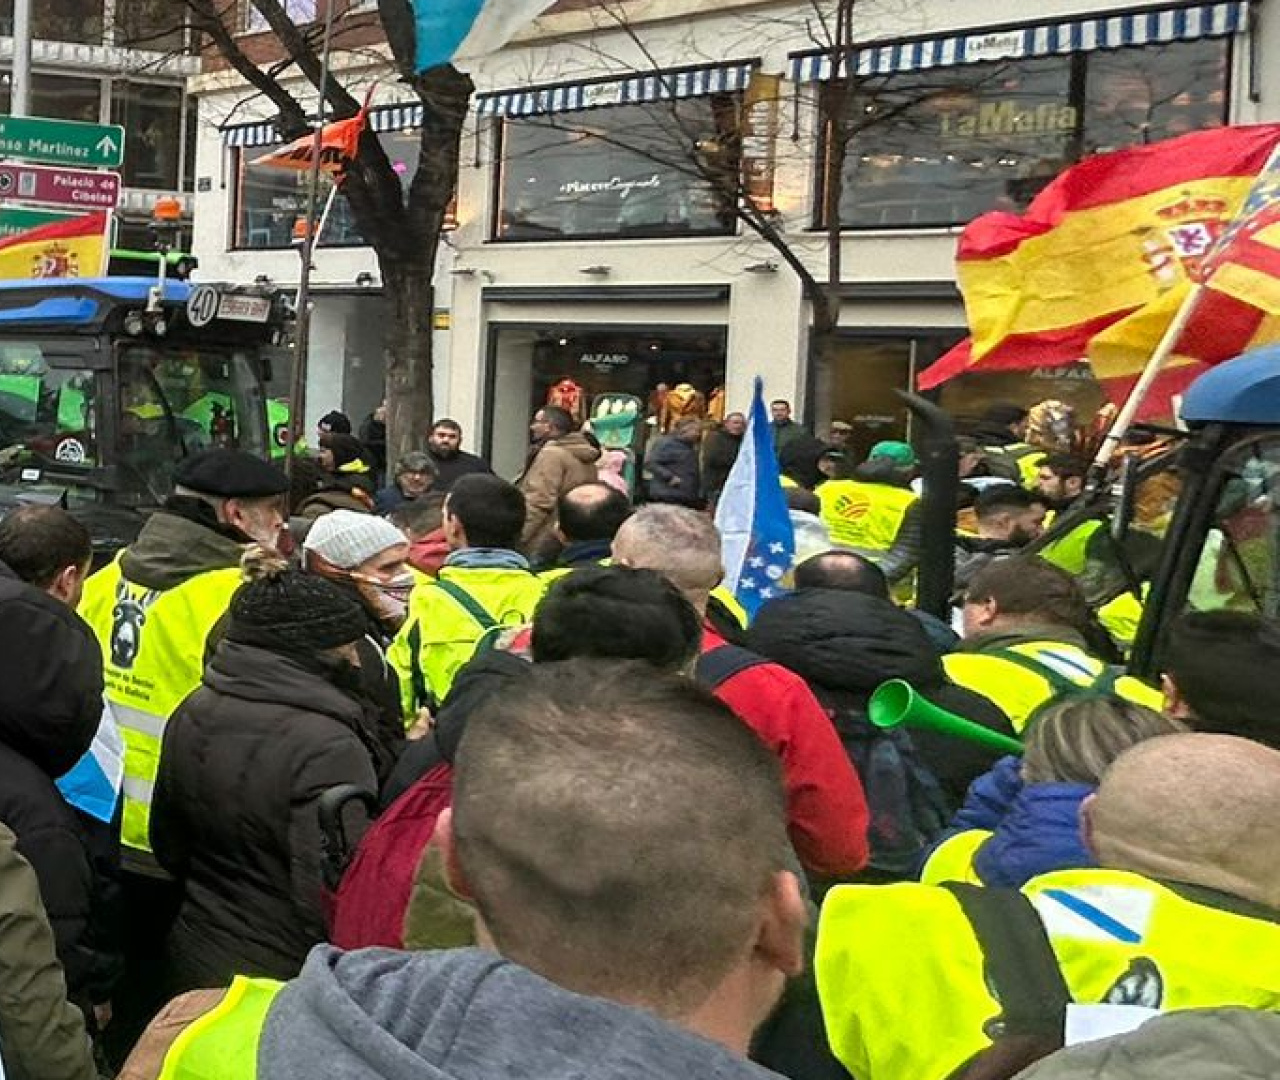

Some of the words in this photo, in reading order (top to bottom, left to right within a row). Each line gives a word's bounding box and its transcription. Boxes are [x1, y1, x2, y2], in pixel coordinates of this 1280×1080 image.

[941, 100, 1078, 135] LaMafia
[53, 175, 94, 188] Palacio
[100, 180, 115, 190] de
[71, 190, 113, 203] Cibeles
[191, 289, 214, 322] 40
[580, 353, 630, 364] ALFARO
